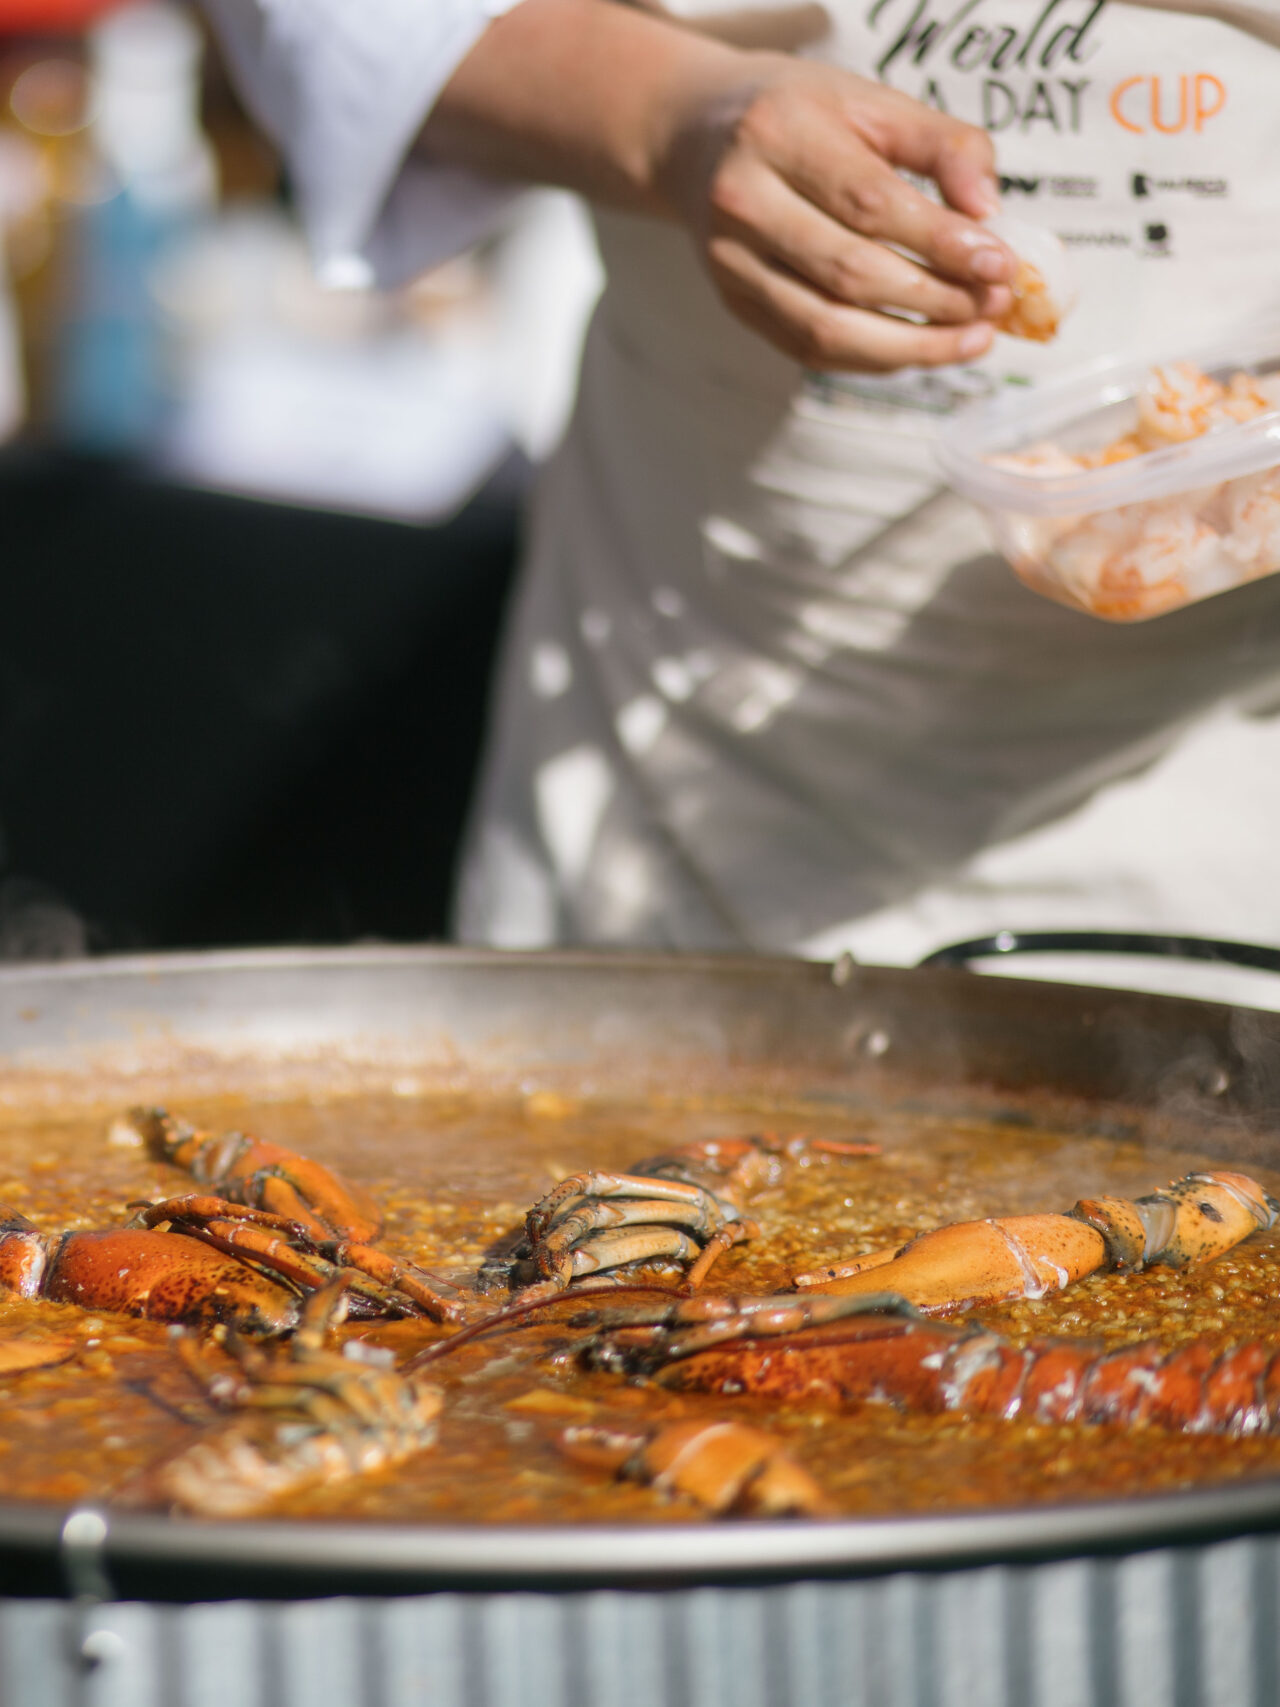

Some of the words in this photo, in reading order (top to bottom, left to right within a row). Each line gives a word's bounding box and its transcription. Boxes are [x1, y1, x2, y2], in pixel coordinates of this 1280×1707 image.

[867, 0, 1106, 78] World
[982, 77, 1091, 134] DAY
[1109, 73, 1227, 134] CUP
